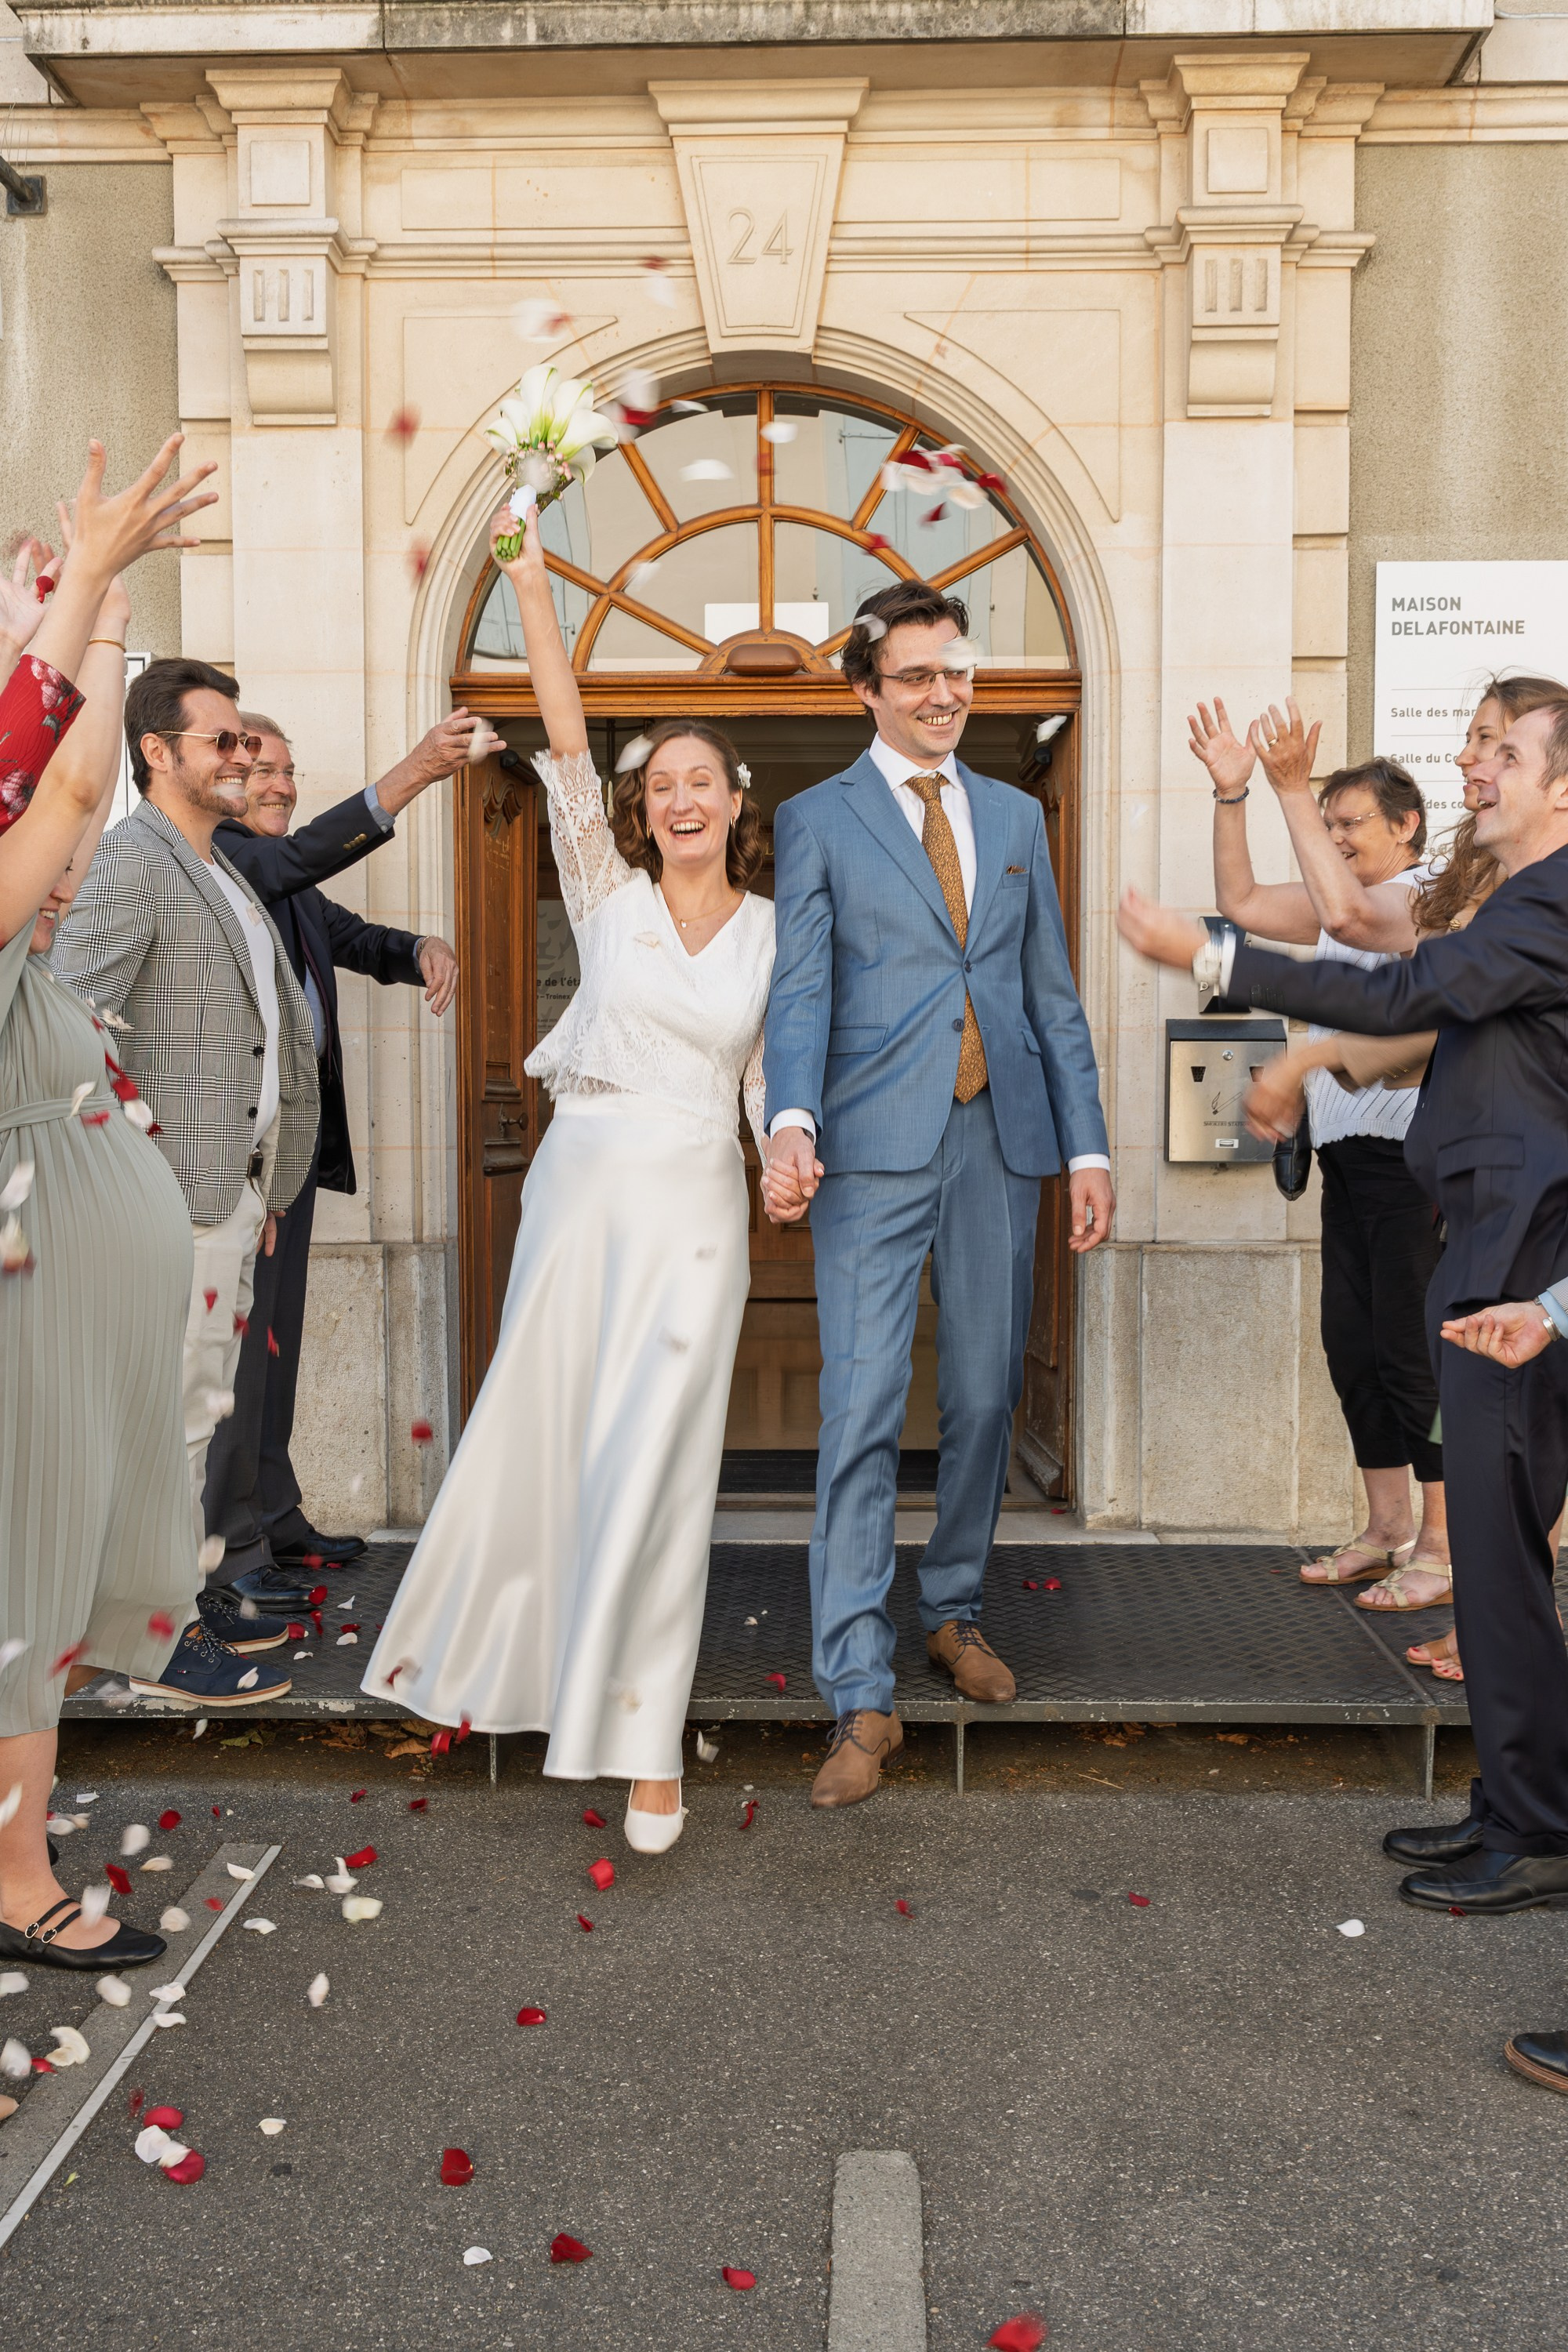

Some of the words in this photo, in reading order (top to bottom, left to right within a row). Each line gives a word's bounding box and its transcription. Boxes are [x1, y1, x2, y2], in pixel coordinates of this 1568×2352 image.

[727, 207, 794, 265] 24
[1392, 597, 1461, 612] MAISON
[1392, 620, 1525, 636] DELAFONTAINE
[1391, 707, 1422, 717] Salle
[1427, 707, 1448, 717] des
[1391, 753, 1421, 764] Salle
[1426, 753, 1441, 763] du
[1426, 800, 1447, 809] des
[545, 978, 557, 987] de
